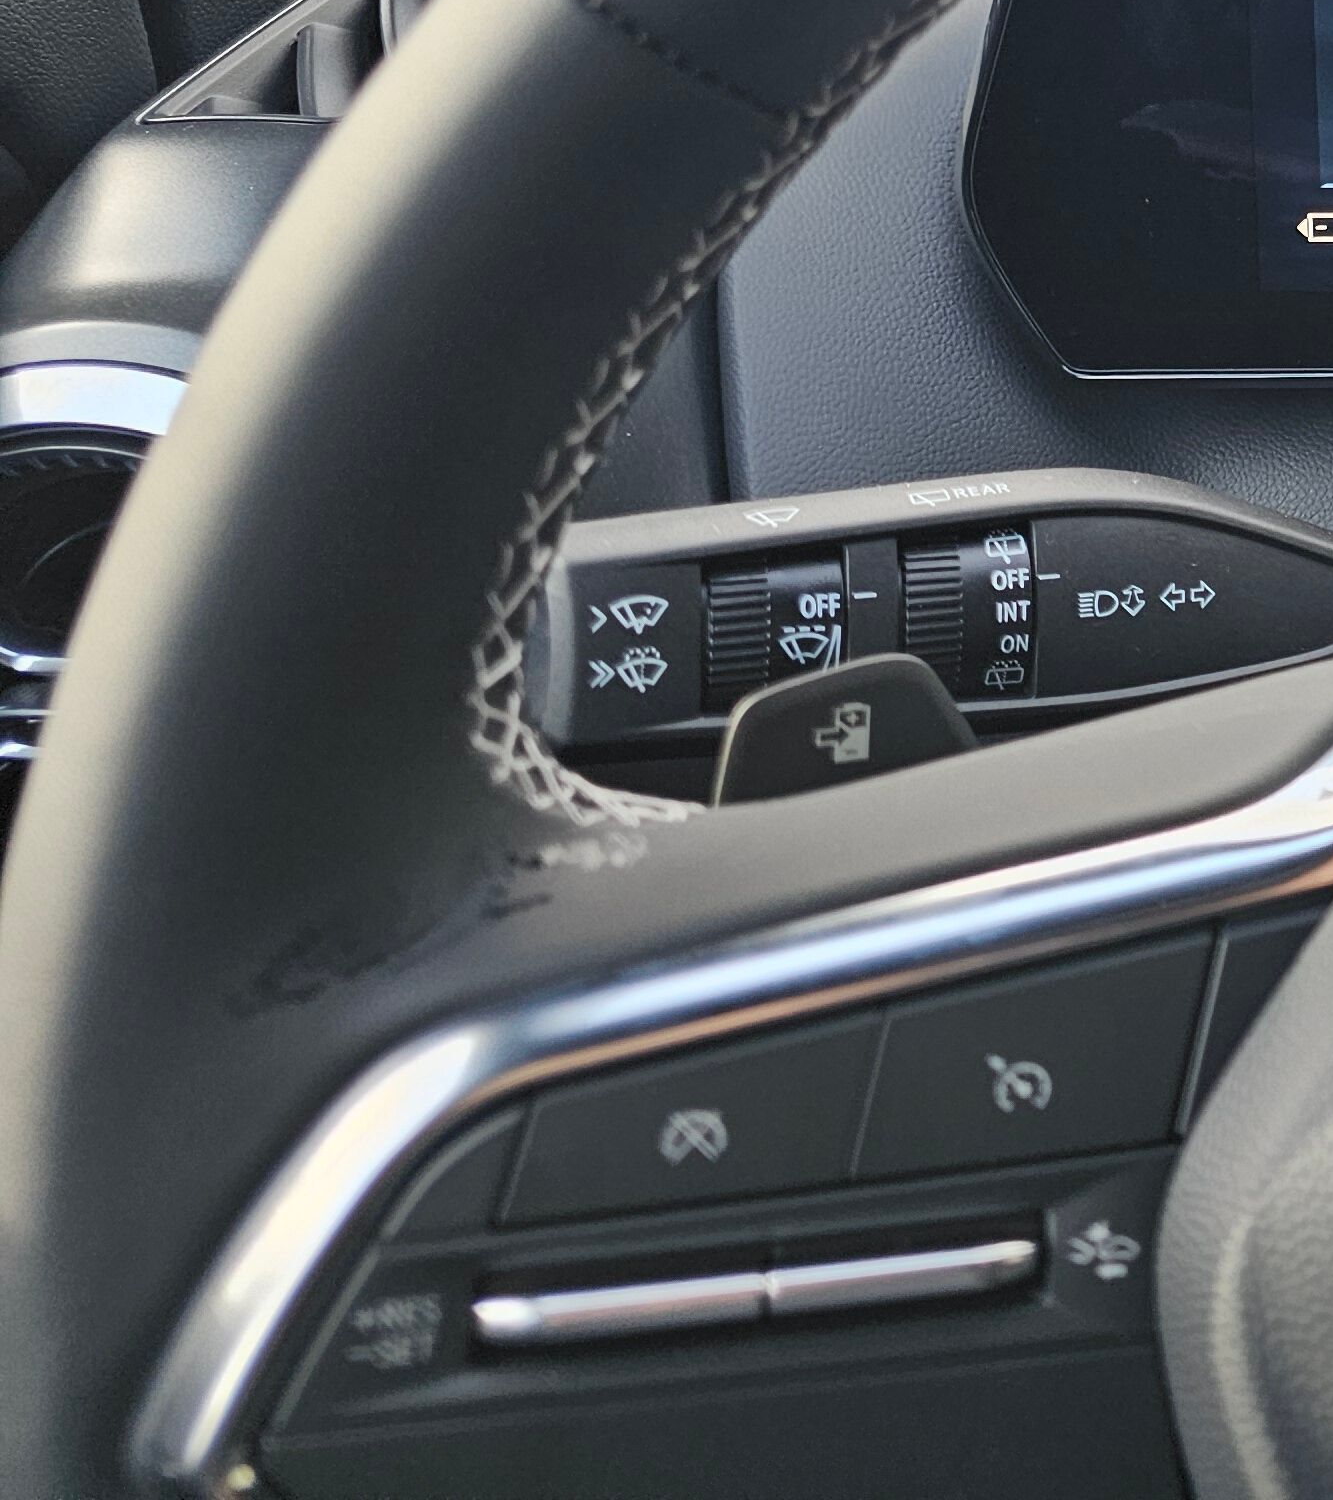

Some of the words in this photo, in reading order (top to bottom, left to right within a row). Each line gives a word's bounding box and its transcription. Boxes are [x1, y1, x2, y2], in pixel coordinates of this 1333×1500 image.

[953, 482, 1011, 498] REAR
[990, 567, 1030, 591] OFF
[798, 592, 841, 619] OFF
[995, 599, 1031, 624] INT
[1000, 633, 1030, 654] ON
